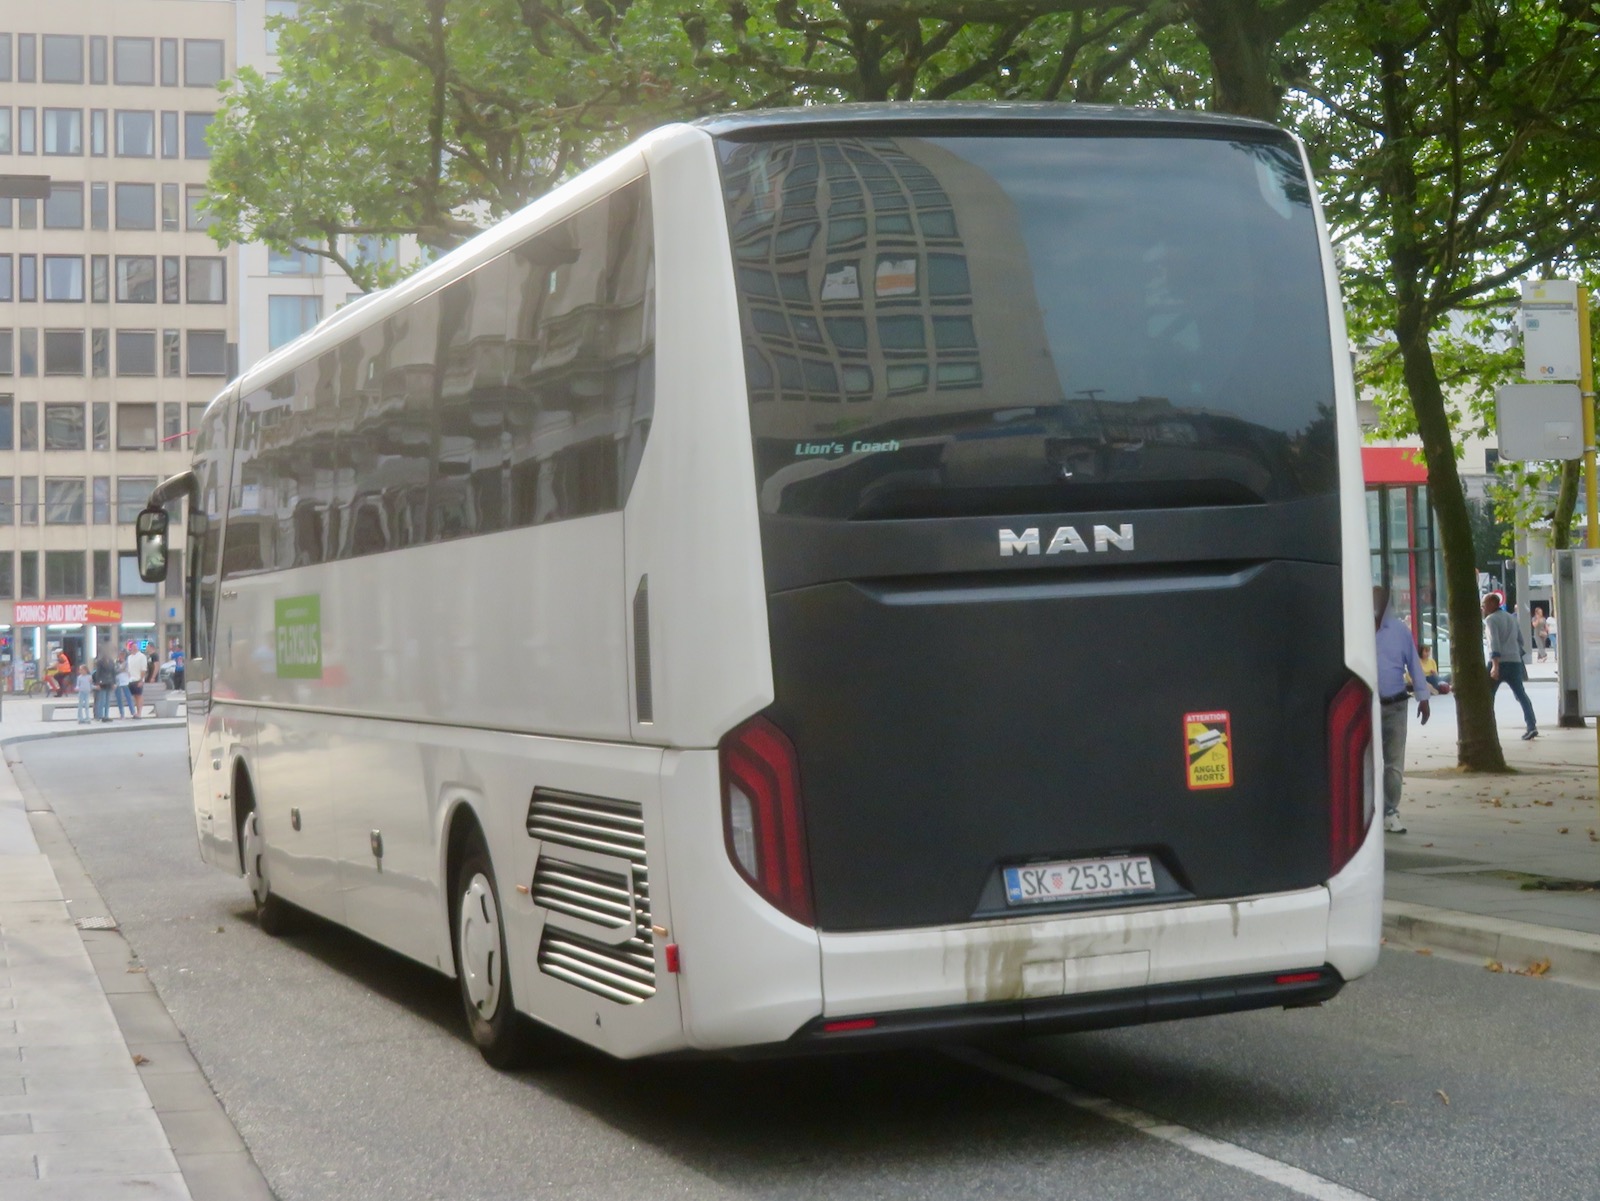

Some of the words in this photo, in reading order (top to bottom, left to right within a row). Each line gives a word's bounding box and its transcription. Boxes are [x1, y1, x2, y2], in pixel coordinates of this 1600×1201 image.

[795, 442, 844, 455] Lion's
[851, 439, 900, 453] Coach
[999, 523, 1134, 557] MAN
[16, 605, 46, 622] DRINKS
[46, 605, 64, 622] AND
[64, 604, 88, 621] MORE
[1186, 713, 1227, 722] ATTENTION
[1193, 764, 1226, 773] ANGLES
[1195, 773, 1225, 783] MORTS
[1022, 869, 1051, 896] SK
[1067, 861, 1151, 891] 253-KE
